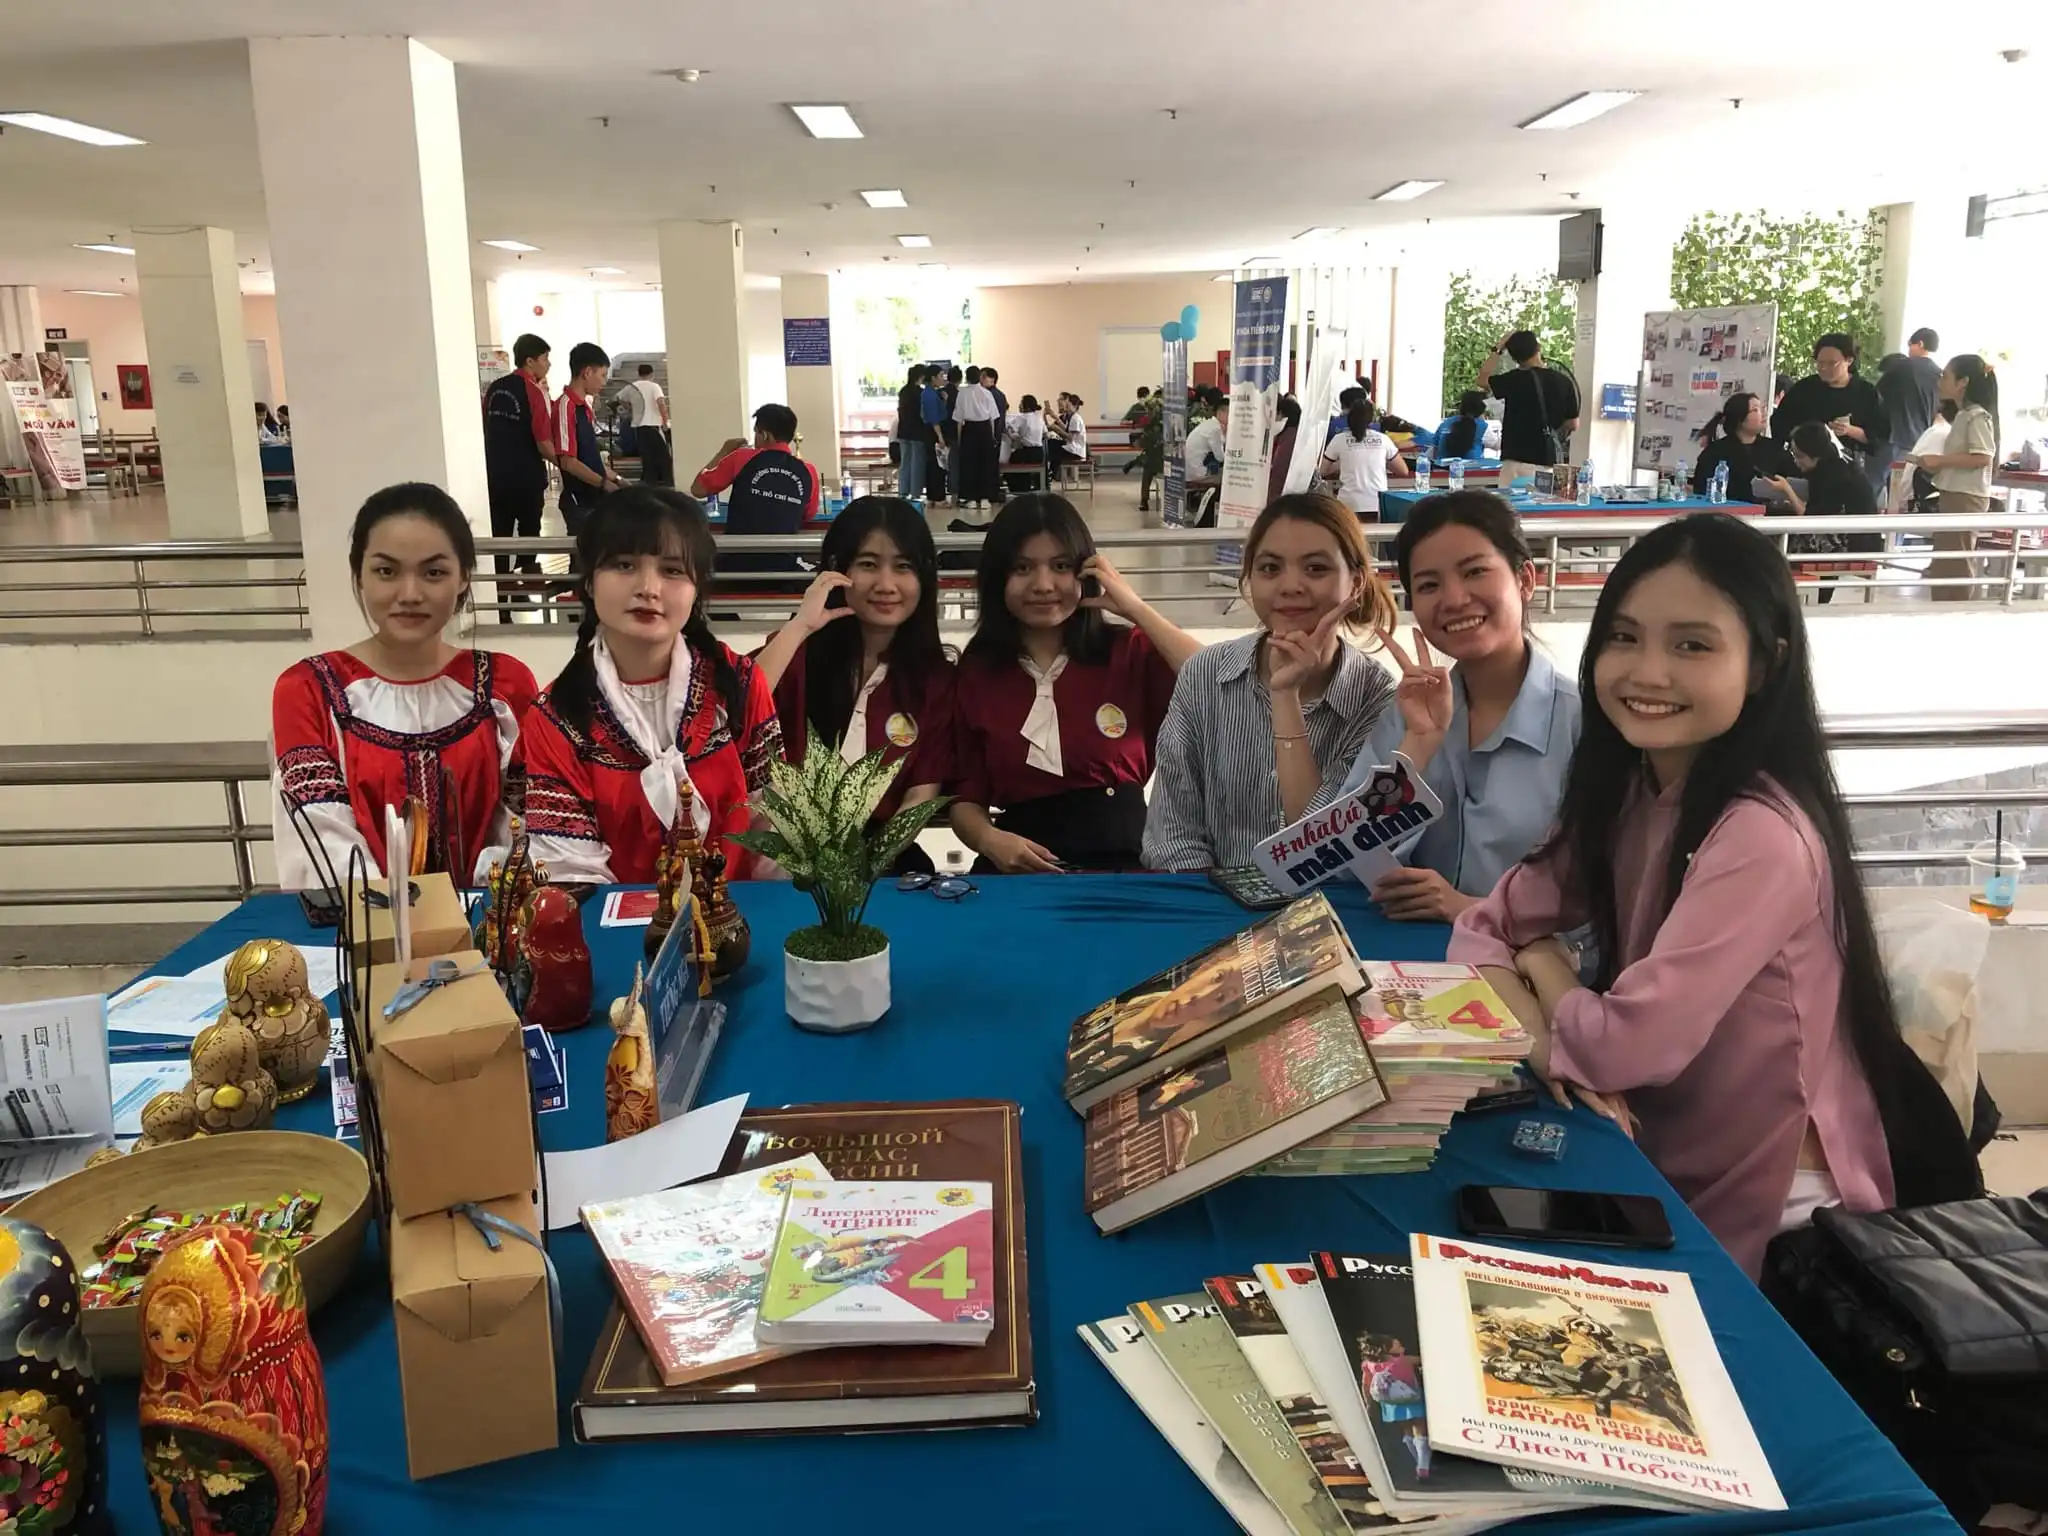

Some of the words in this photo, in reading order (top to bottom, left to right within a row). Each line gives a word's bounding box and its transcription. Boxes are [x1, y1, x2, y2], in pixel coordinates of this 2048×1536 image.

[47, 418, 75, 429] VĂN
[1285, 837, 1355, 887] mãi
[1448, 1000, 1505, 1029] 4
[766, 1127, 945, 1150] БОЛЬШОЙ
[819, 1147, 908, 1163] ТЛАС
[828, 1163, 921, 1179] ССИИ
[801, 1206, 940, 1218] Литературное
[822, 1217, 918, 1230] ЧТЕНИЕ
[908, 1246, 976, 1299] 4
[787, 1289, 801, 1300] 2
[1486, 1398, 1554, 1416] БОРИСЬ
[1563, 1411, 1586, 1422] ДО
[1462, 1417, 1485, 1427] МЫ
[1560, 1433, 1569, 1442] И
[1573, 1439, 1627, 1455] ДРУГИЕ
[1631, 1450, 1677, 1465] ПУСТЬ
[1487, 1405, 1591, 1432] КАПЛИ
[1601, 1427, 1708, 1457] КРОВИ
[1462, 1428, 1484, 1444] С
[1495, 1434, 1591, 1464] Днем
[1601, 1453, 1753, 1498] Победы!
